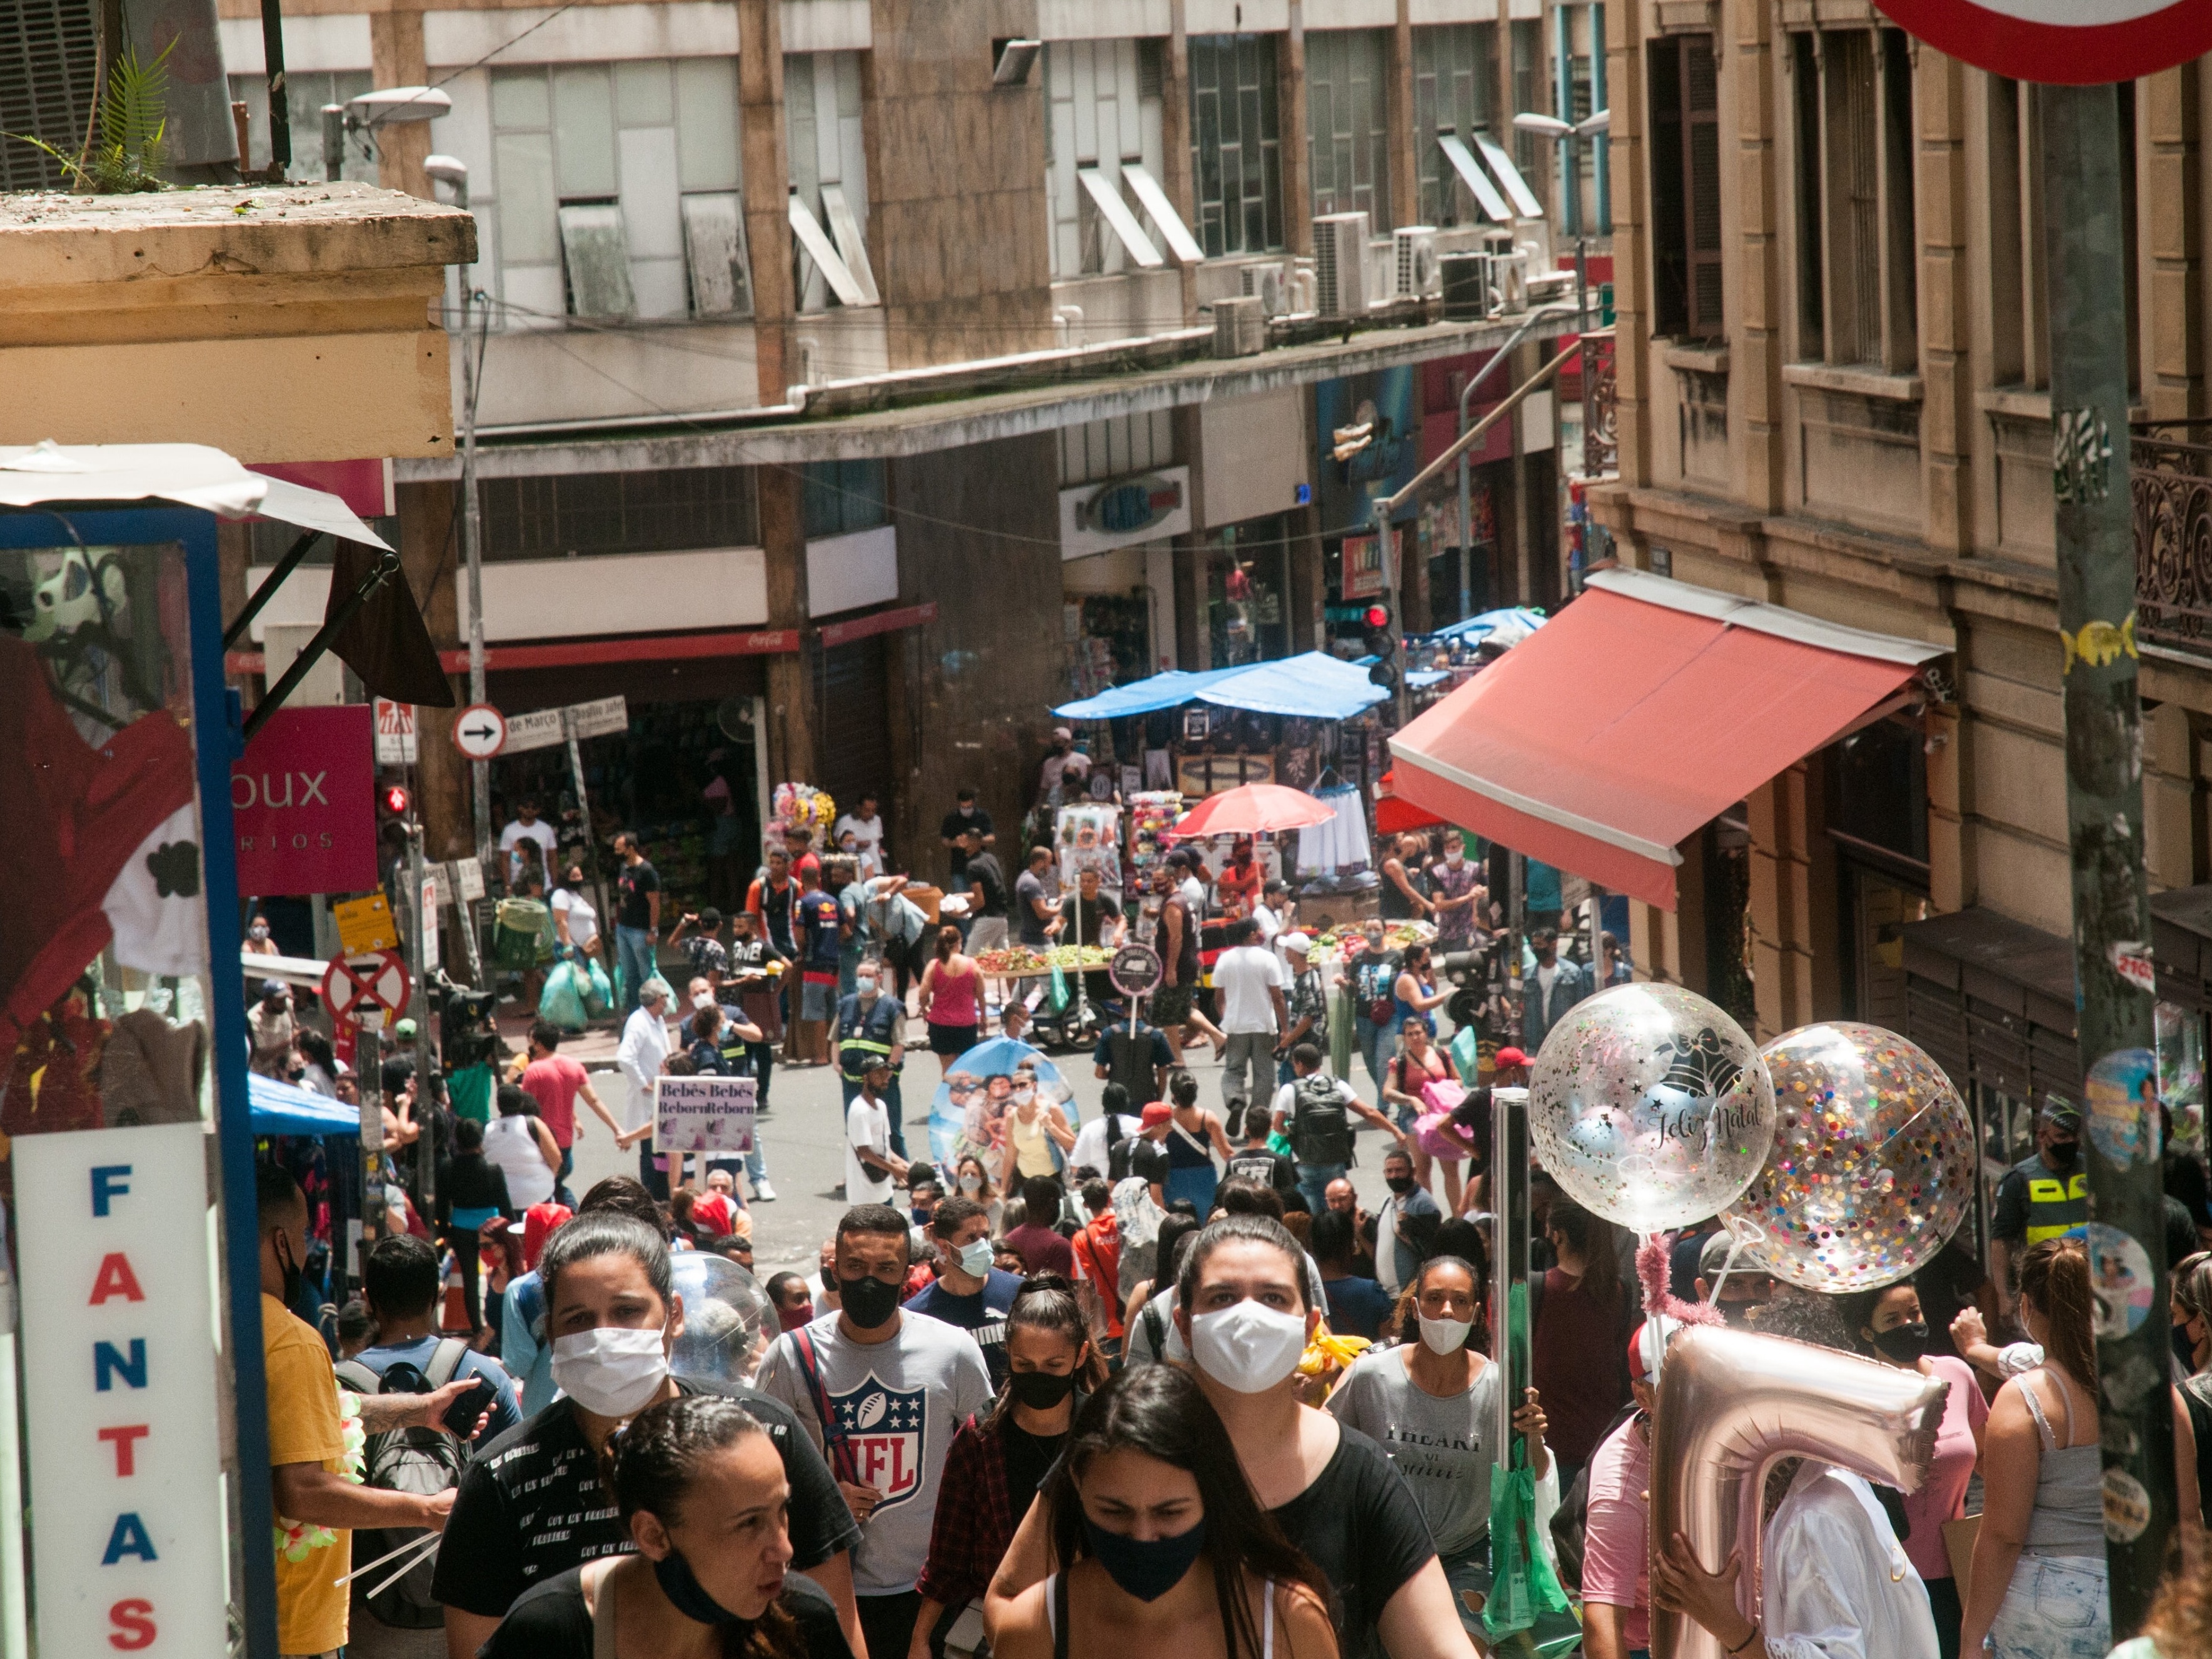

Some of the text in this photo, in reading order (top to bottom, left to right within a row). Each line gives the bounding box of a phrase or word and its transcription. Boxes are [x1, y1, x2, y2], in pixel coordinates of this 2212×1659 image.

[240, 832, 333, 851] RIOS
[661, 1083, 753, 1098] Bebês Bebês
[659, 1101, 754, 1114] Reborn Reborn
[1647, 1096, 1762, 1152] Feliz Natal
[88, 1164, 159, 1651] FANTAS
